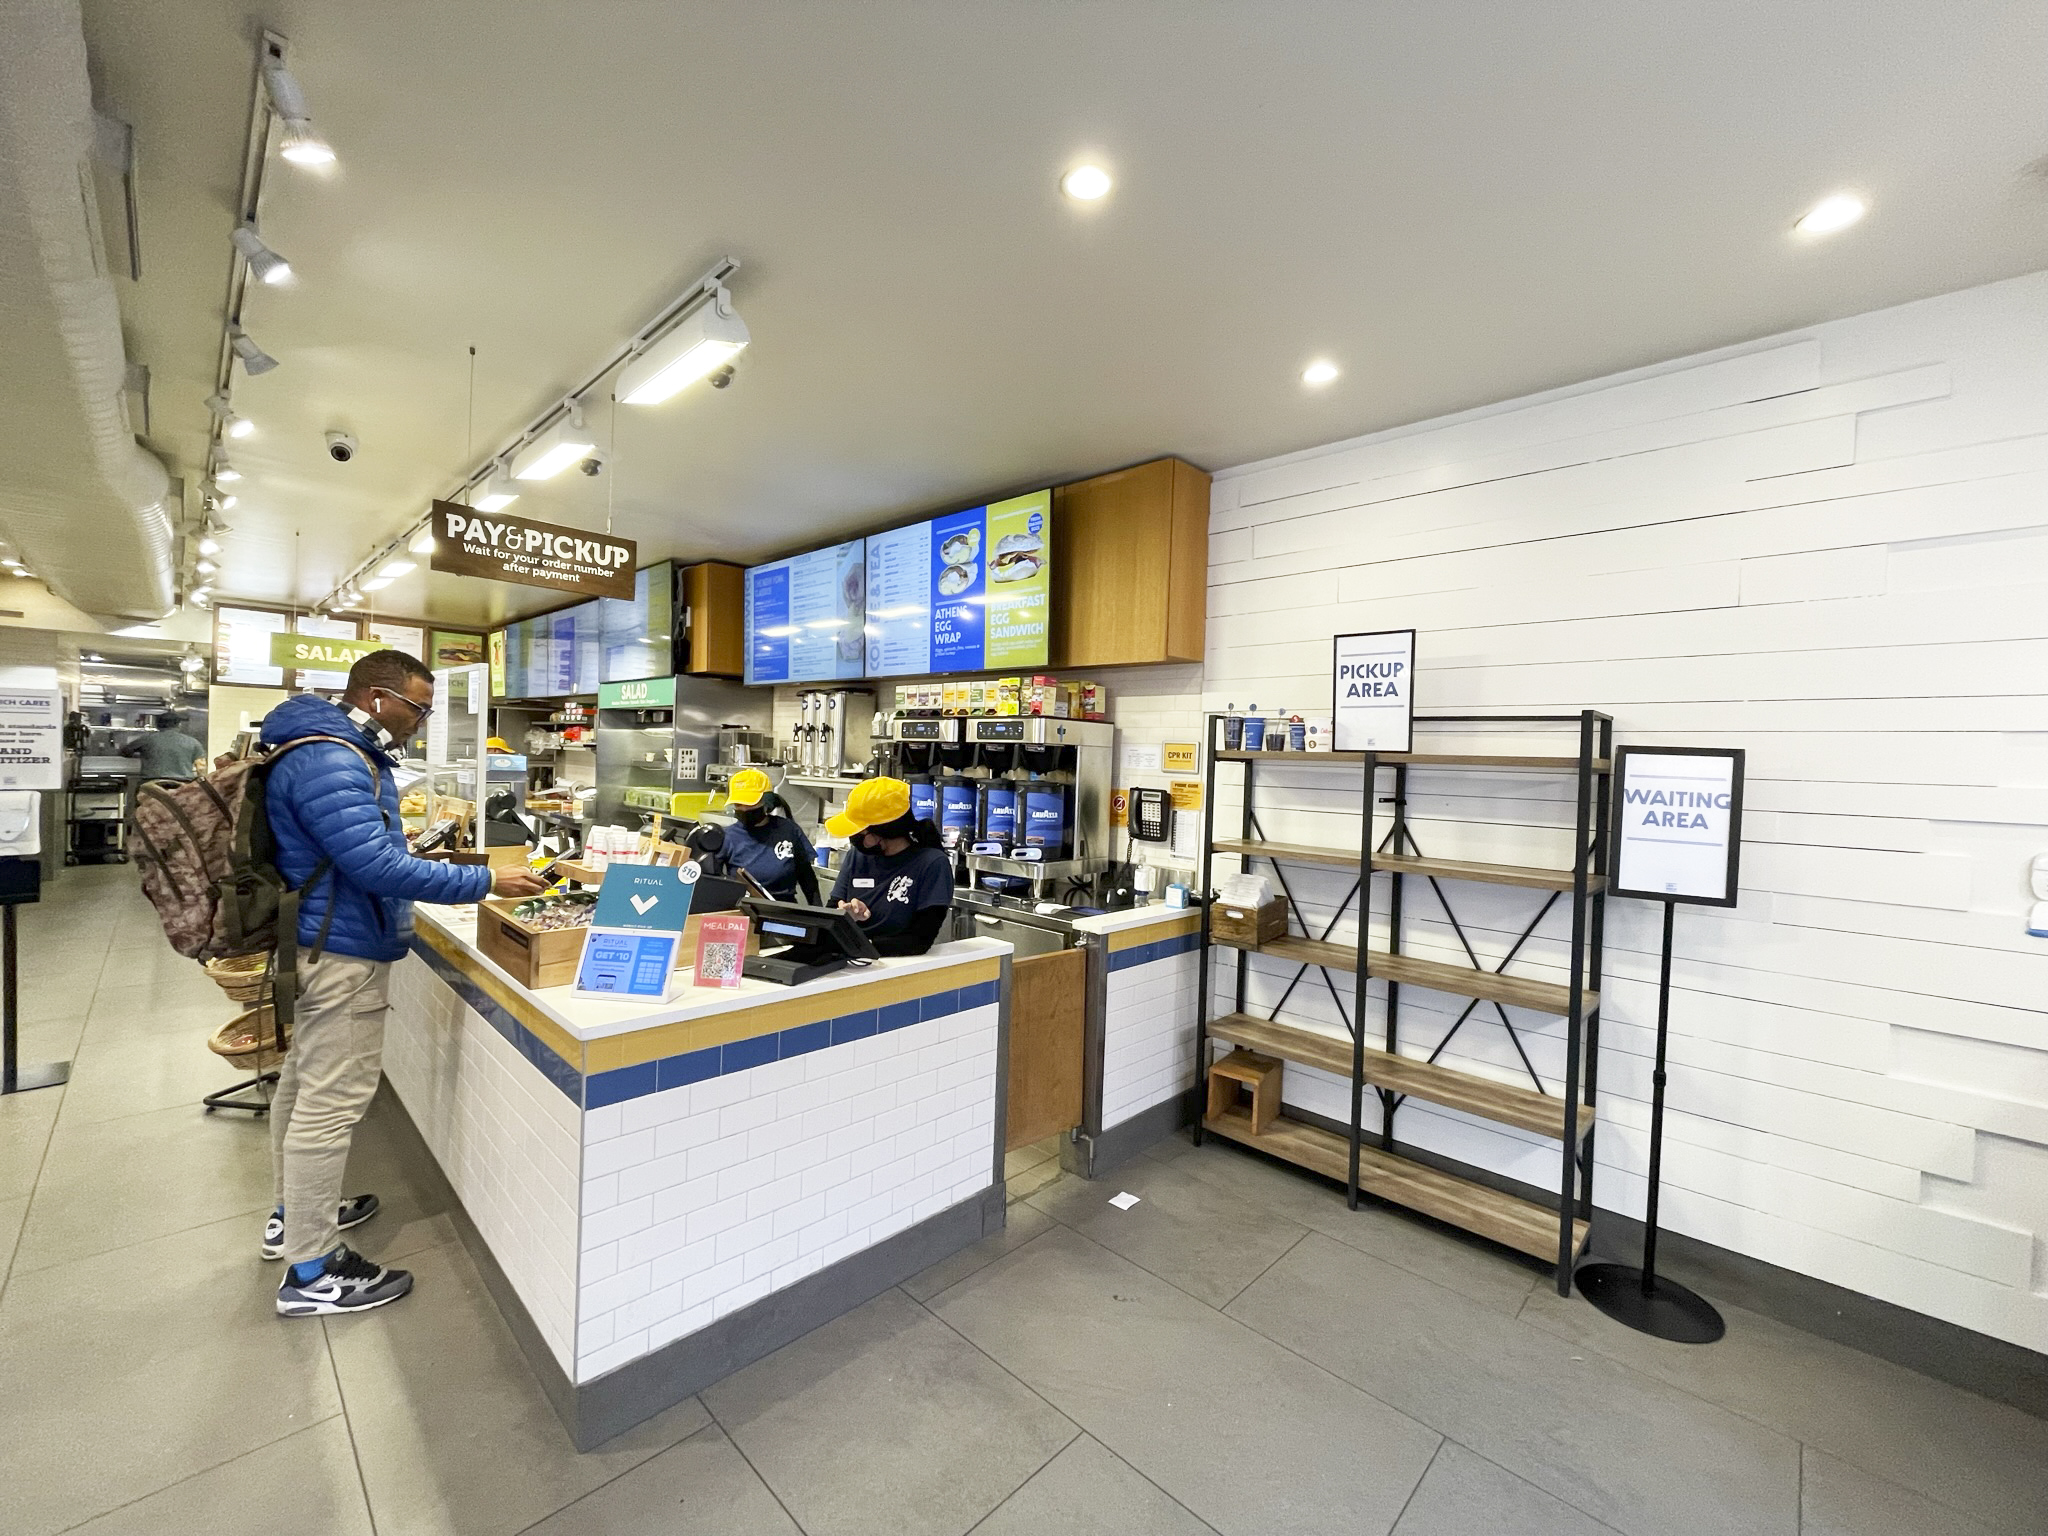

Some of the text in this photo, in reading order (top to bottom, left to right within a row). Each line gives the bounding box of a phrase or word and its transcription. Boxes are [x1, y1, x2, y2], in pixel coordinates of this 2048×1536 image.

[463, 542, 614, 578] Wait for your order number
[869, 543, 881, 582] TEA
[502, 562, 580, 583] after payment
[990, 594, 1046, 612] BREAKFAST
[935, 605, 968, 620] ATHENS
[990, 612, 1010, 625] EGG
[935, 621, 952, 633] EGG
[990, 622, 1044, 639] SANDWICH
[869, 601, 881, 672] COFEE
[935, 632, 962, 645] WRAP
[1340, 662, 1405, 680] PICKUP
[621, 683, 648, 700] SALAD
[1346, 681, 1399, 698] AREA
[1168, 751, 1193, 760] CPR KIT
[1624, 788, 1732, 810] WAITING
[1641, 810, 1709, 830] AREA
[681, 865, 698, 880] $10
[634, 877, 664, 886] RITUAL
[703, 921, 746, 932] MEALPAL
[602, 938, 628, 946] RITUAL
[595, 951, 615, 960] GET
